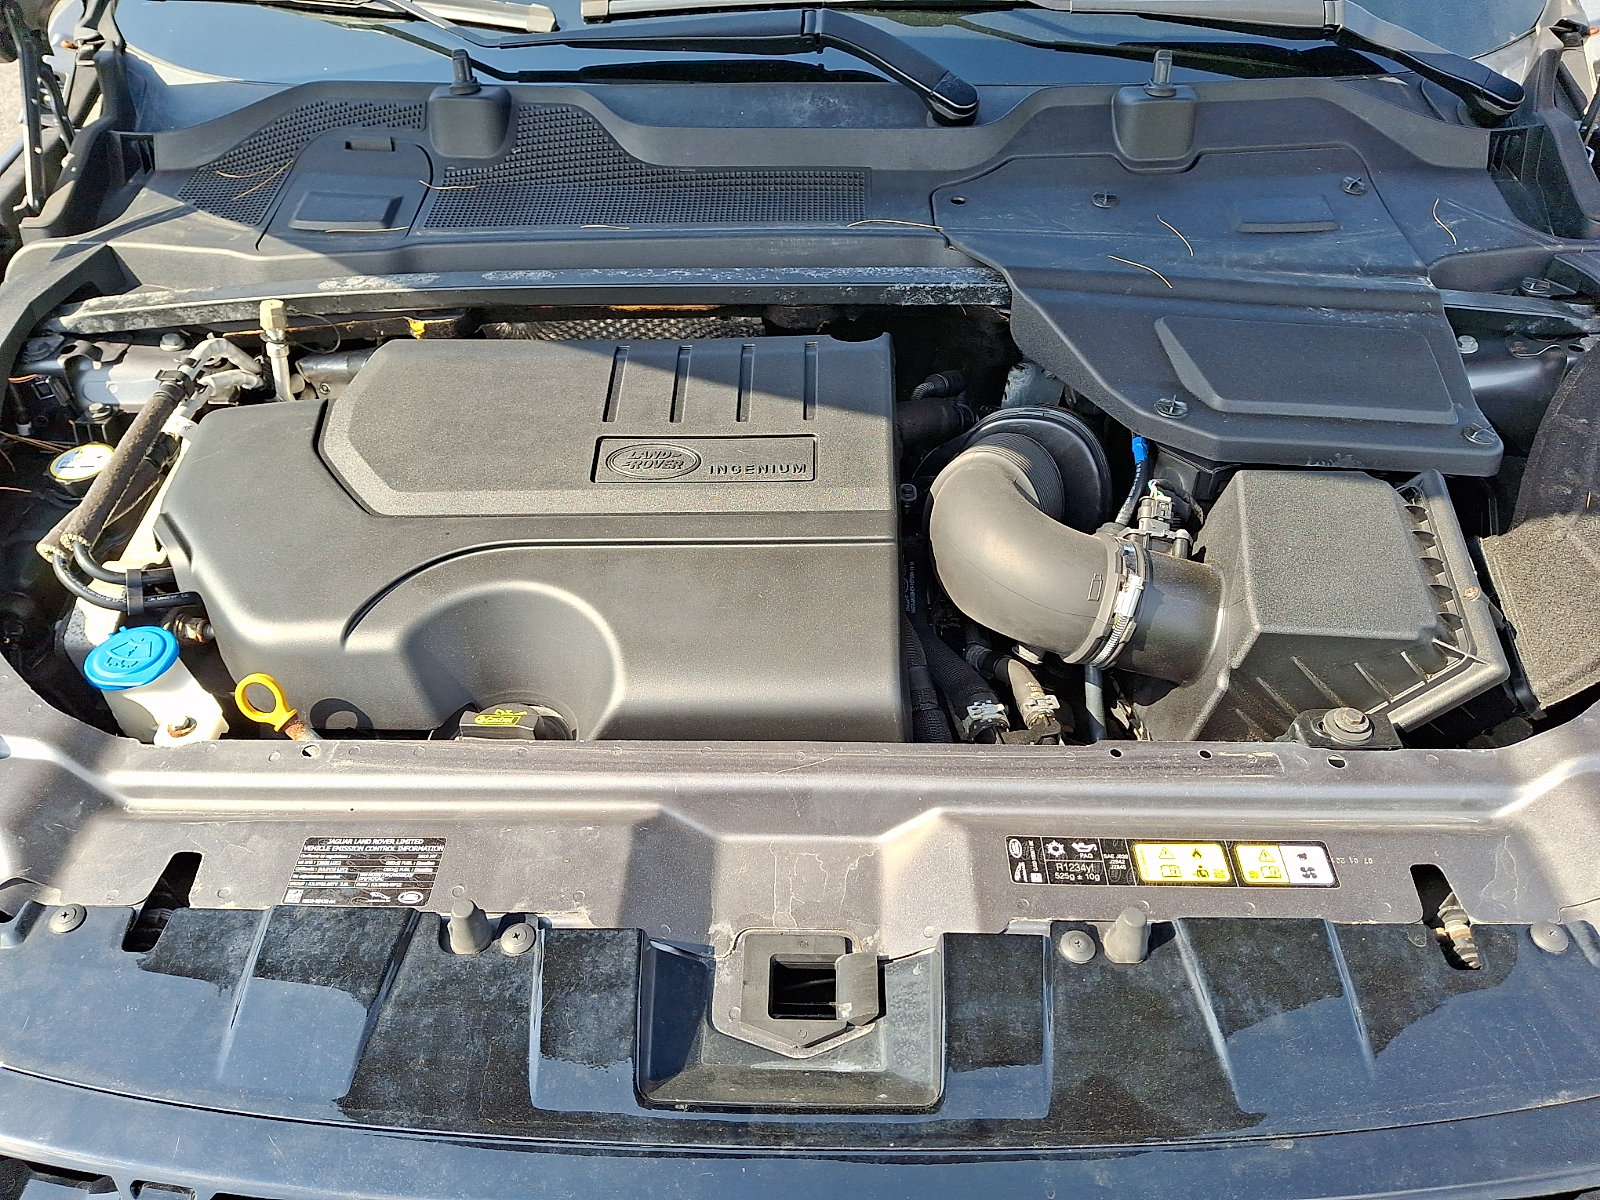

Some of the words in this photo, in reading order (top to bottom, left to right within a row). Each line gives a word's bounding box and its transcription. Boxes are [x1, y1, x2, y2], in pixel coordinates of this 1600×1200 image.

[708, 463, 808, 475] INGENIUM
[397, 844, 444, 852] INFORMATION
[1055, 862, 1094, 873] R1234yf
[1054, 872, 1075, 881] 525g
[1085, 872, 1101, 882] 10g
